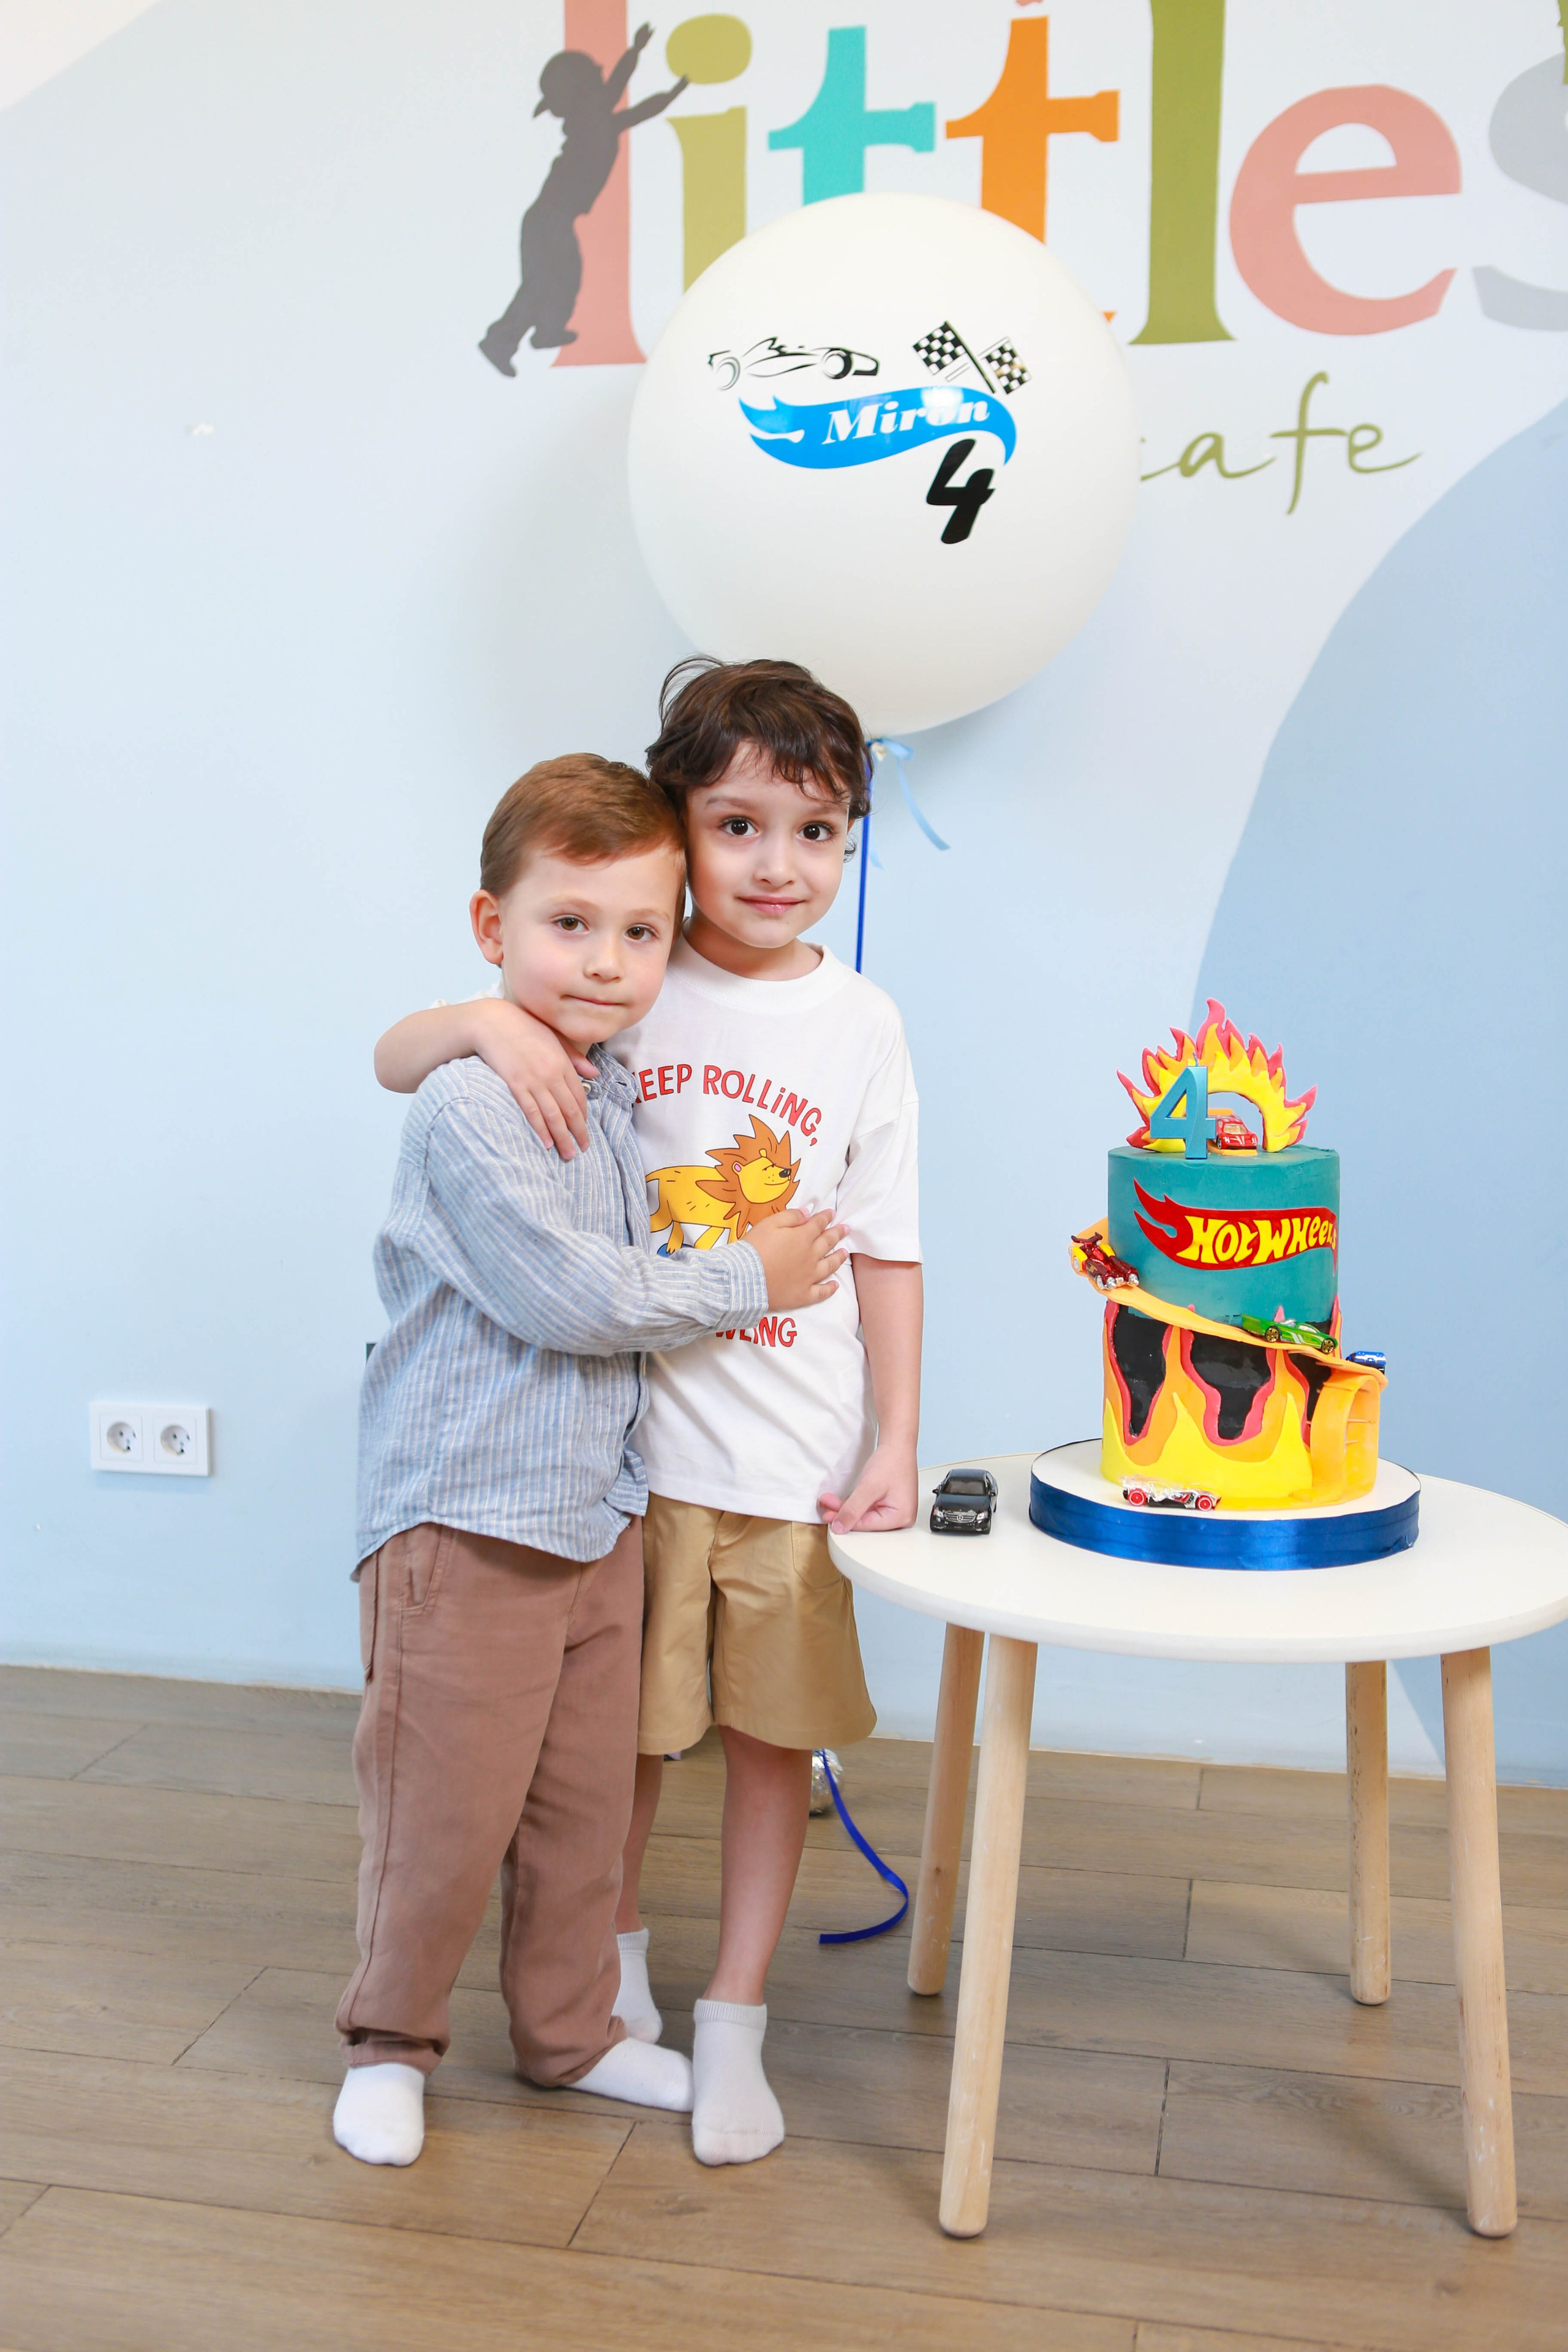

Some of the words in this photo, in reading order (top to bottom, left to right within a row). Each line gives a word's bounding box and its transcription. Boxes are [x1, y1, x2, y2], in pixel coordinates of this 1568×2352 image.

[821, 401, 990, 445] Miron
[1140, 371, 1423, 514] afe
[925, 439, 997, 544] 4
[631, 1063, 692, 1107] EEP
[1150, 1066, 1216, 1159] 4
